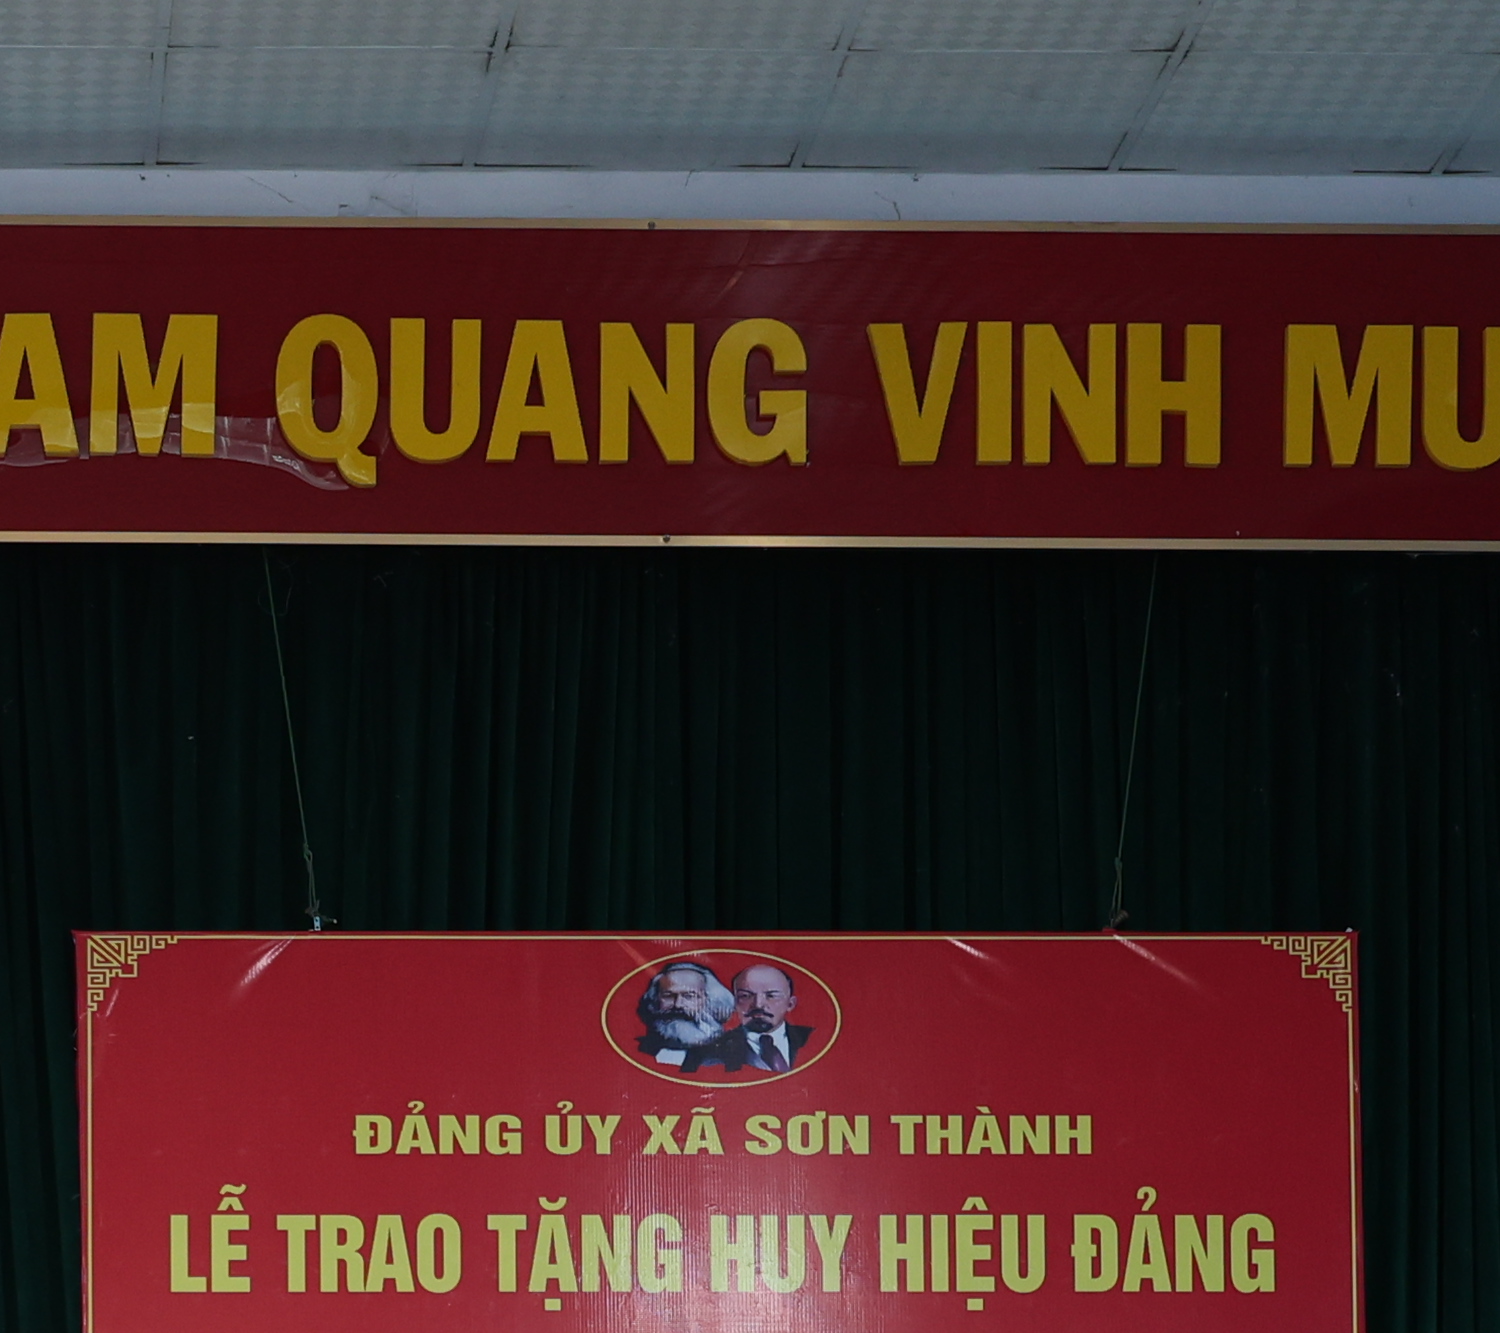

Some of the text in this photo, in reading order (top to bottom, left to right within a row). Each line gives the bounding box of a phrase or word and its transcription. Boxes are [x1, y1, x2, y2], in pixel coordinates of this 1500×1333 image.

[274, 312, 809, 486] QUANG
[868, 320, 1222, 466] VINH
[352, 1099, 1093, 1156] ĐẢNG ỦY XÃ SƠN THÀNH
[169, 1182, 1276, 1312] LỄ TRAO TẶNG HUY HIỆU ĐẢNG
